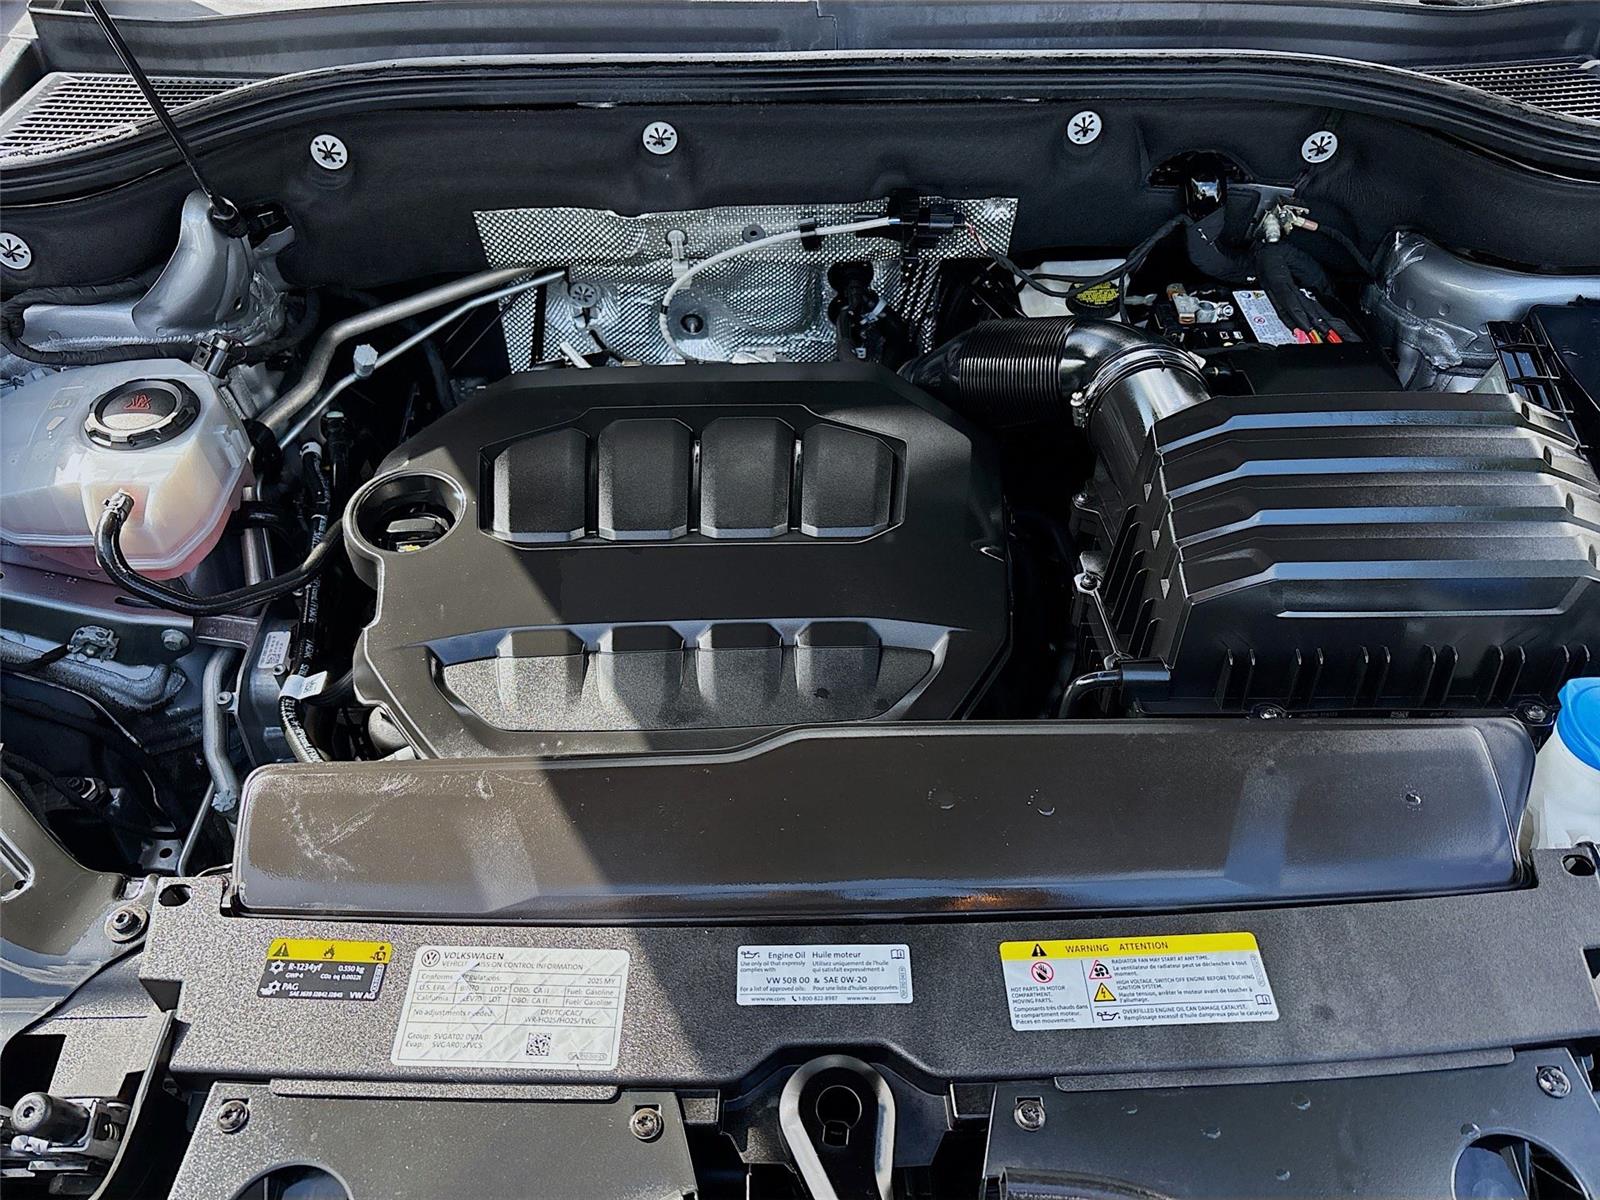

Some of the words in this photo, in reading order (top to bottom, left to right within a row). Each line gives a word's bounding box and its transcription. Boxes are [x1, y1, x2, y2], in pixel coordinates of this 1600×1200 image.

[1065, 944, 1109, 953] WARNING
[1120, 942, 1168, 950] ATTENTION
[444, 952, 504, 960] VOLKSWAGEN
[768, 952, 793, 960] Engine
[288, 962, 323, 973] R-1234yf
[356, 966, 365, 974] kg
[536, 962, 584, 970] INFORMATION
[281, 983, 299, 991] PAG
[349, 991, 362, 999] VW
[1013, 1005, 1045, 1013] Composants
